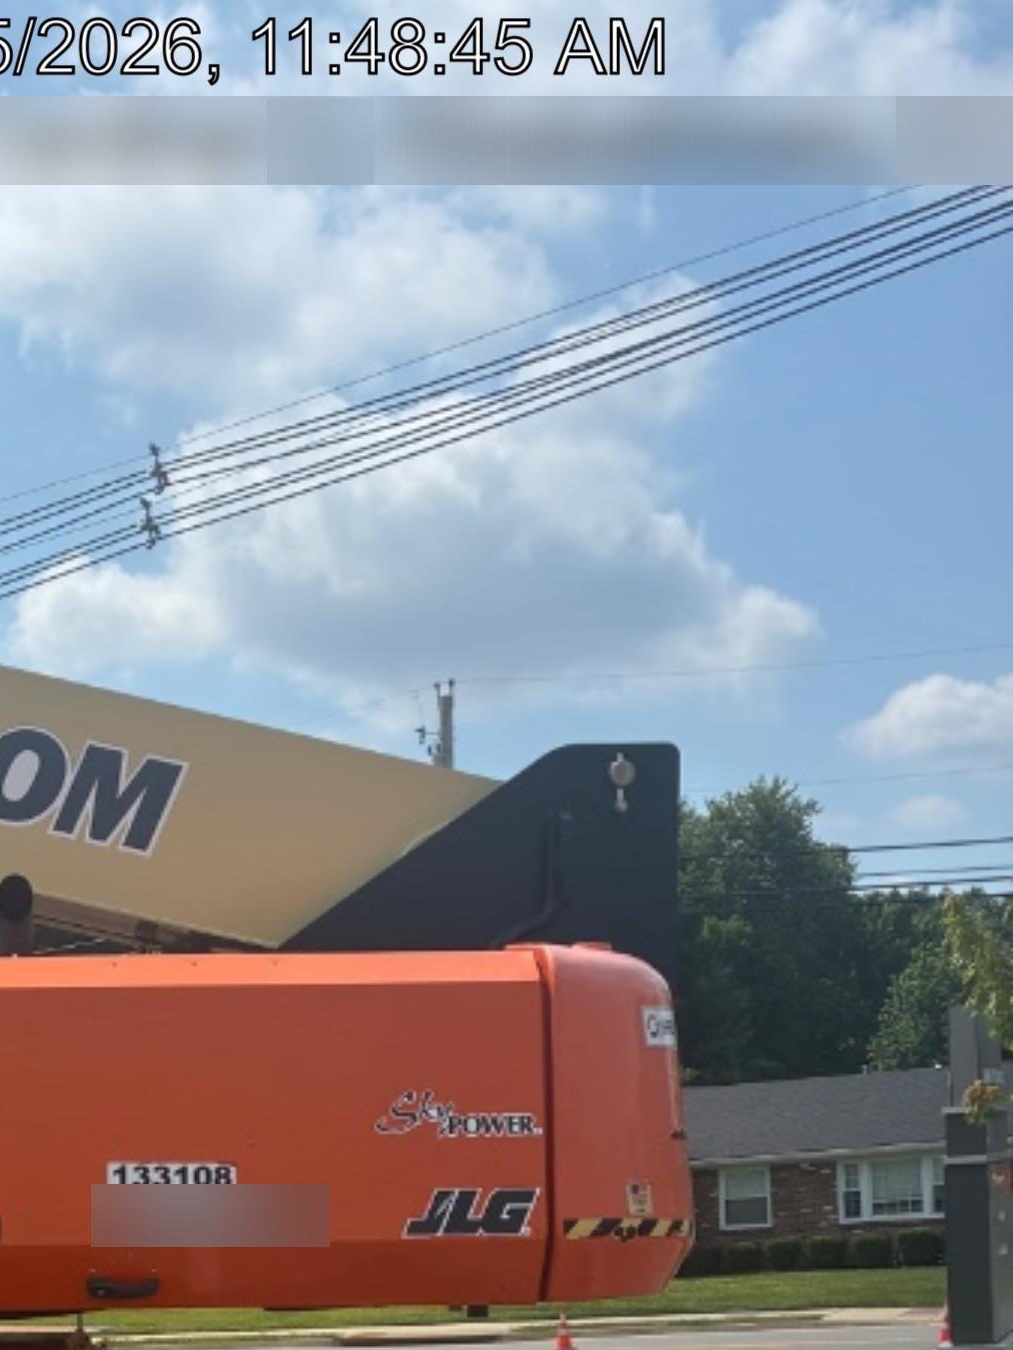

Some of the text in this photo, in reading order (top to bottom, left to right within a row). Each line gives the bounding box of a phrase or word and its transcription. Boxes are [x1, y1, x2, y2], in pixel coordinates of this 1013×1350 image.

[374, 1090, 535, 1138] Sky POWER
[401, 1188, 540, 1239] JLG
